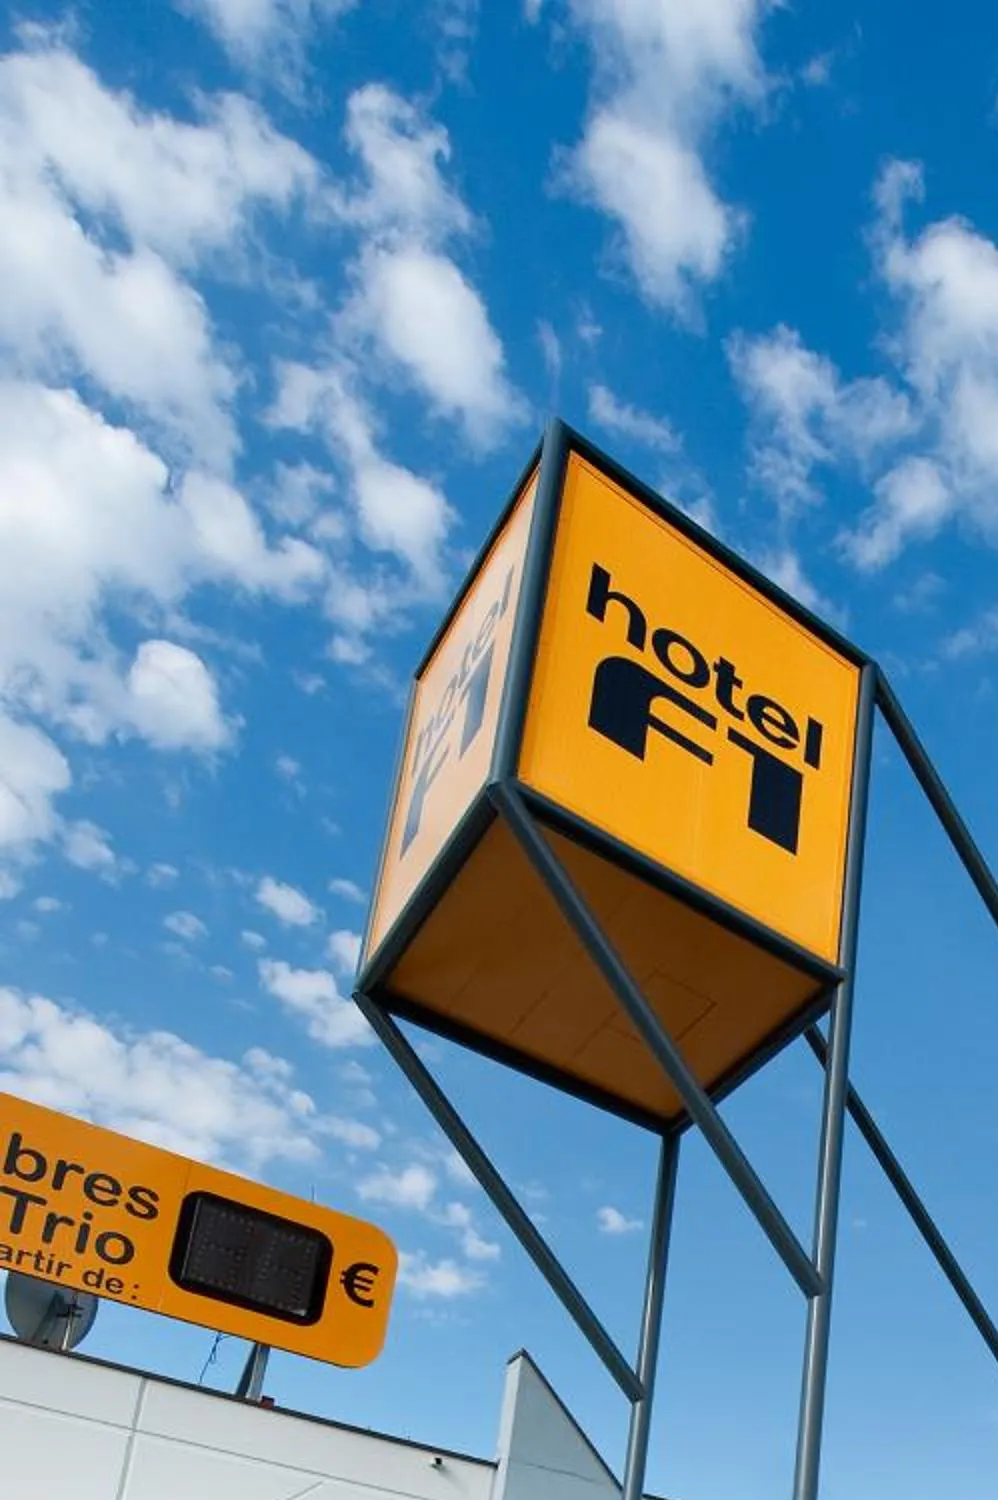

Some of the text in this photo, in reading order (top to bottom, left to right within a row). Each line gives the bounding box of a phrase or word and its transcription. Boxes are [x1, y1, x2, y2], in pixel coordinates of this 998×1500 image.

[586, 562, 823, 770] hotel
[588, 656, 804, 856] F1
[3, 1132, 159, 1220] bres
[0, 1185, 135, 1265] Trio
[340, 1262, 380, 1308] €
